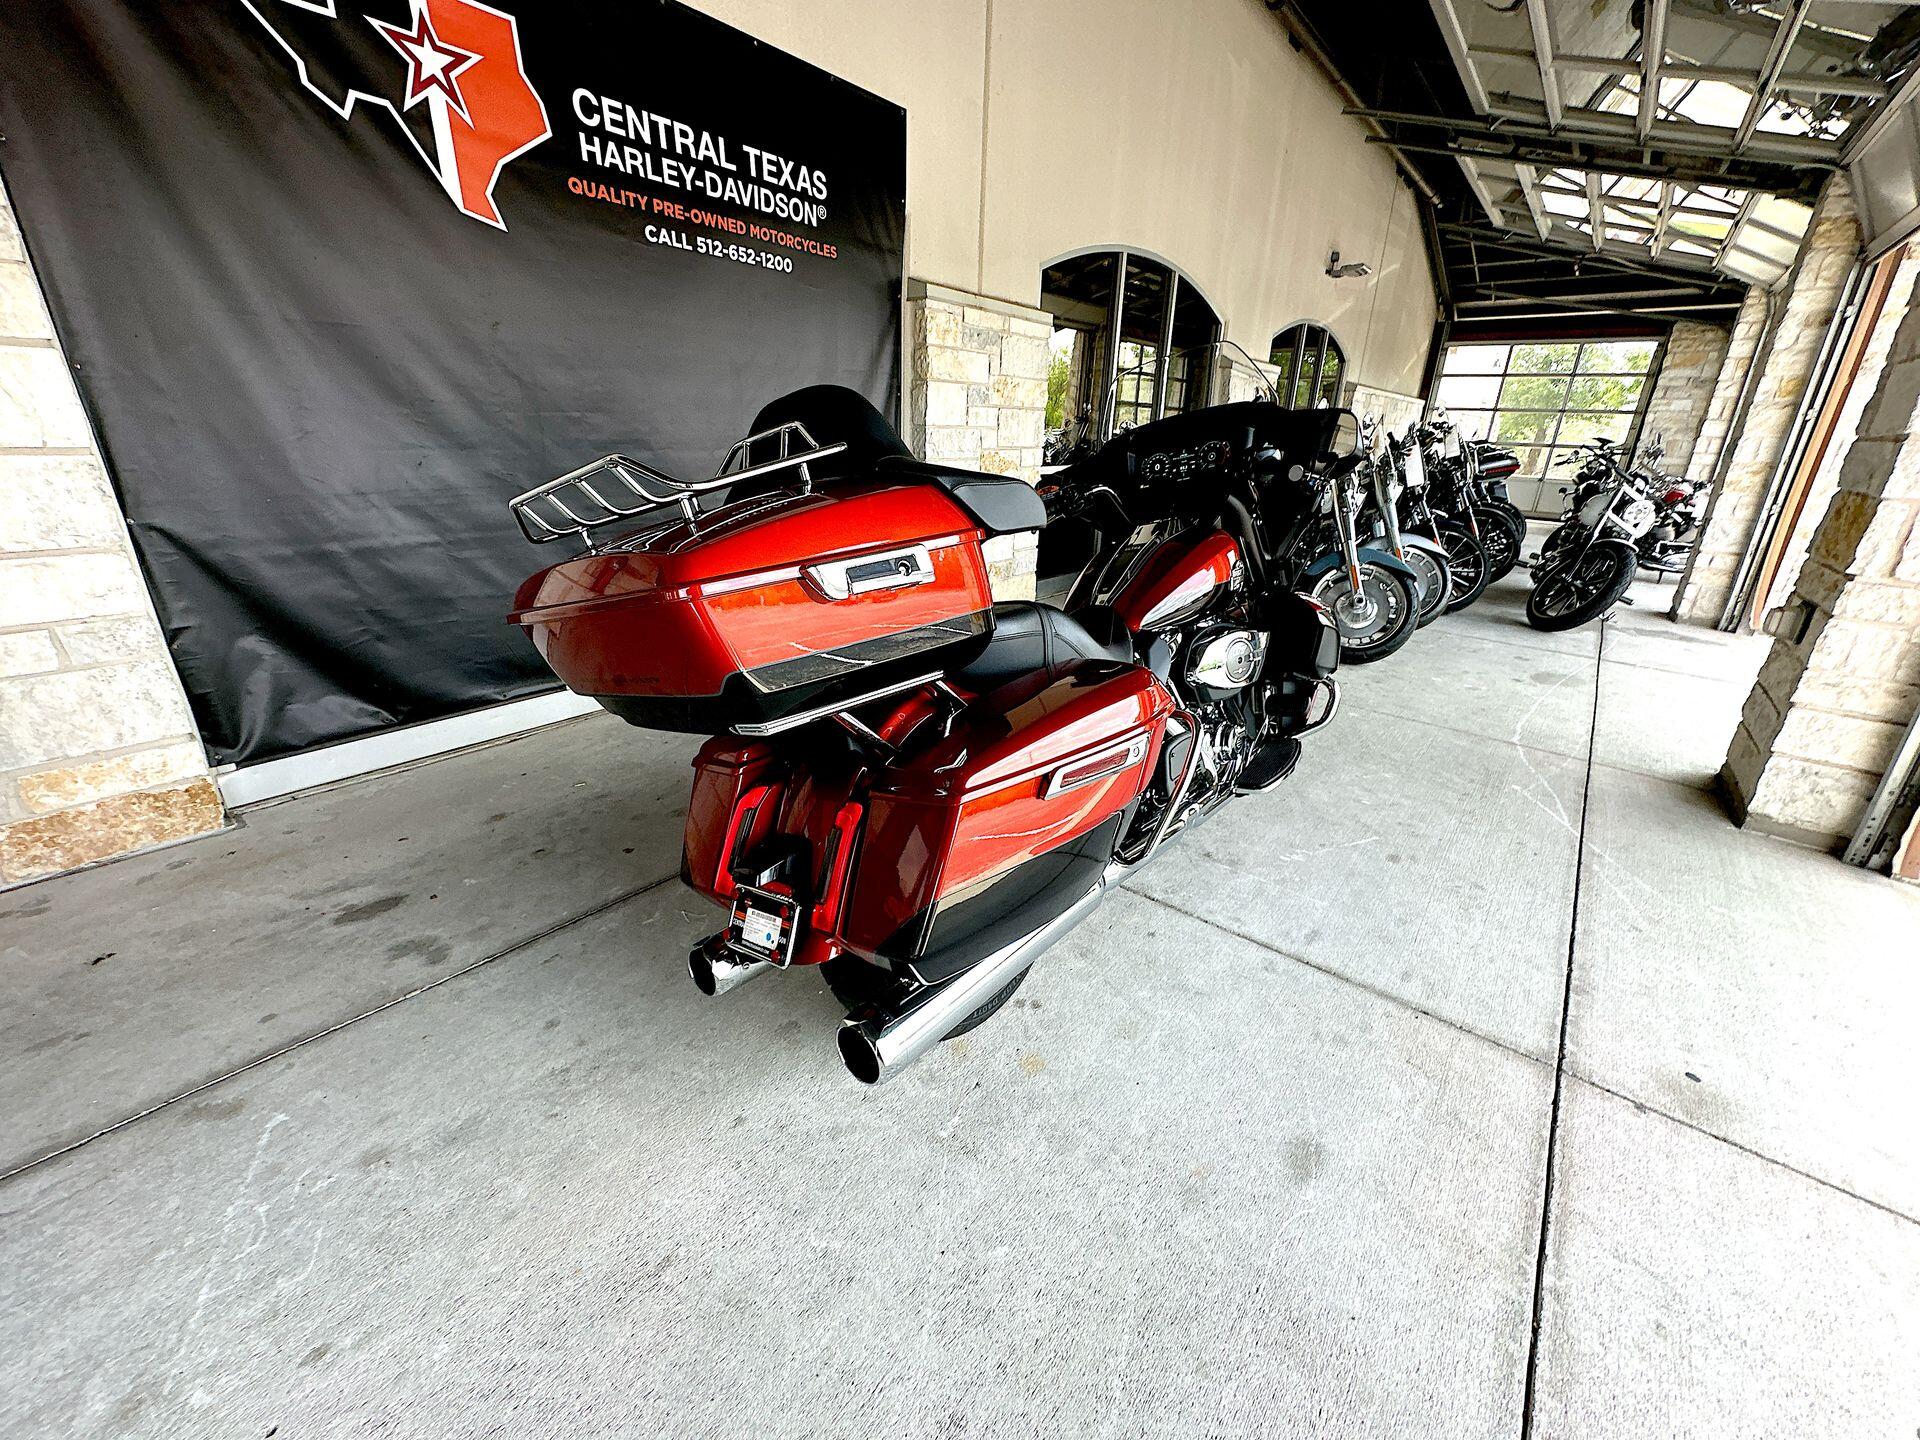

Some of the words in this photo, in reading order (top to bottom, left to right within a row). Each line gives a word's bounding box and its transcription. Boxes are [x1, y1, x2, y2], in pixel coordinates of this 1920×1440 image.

[572, 87, 737, 172] CENTRAL
[742, 144, 828, 200] TEXAS
[567, 176, 648, 211] QUALITY
[652, 198, 747, 235] PRE-OWNED
[749, 223, 838, 259] MOTORCYCLES
[644, 224, 693, 251] CALL
[696, 236, 793, 273] 512-652-1200
